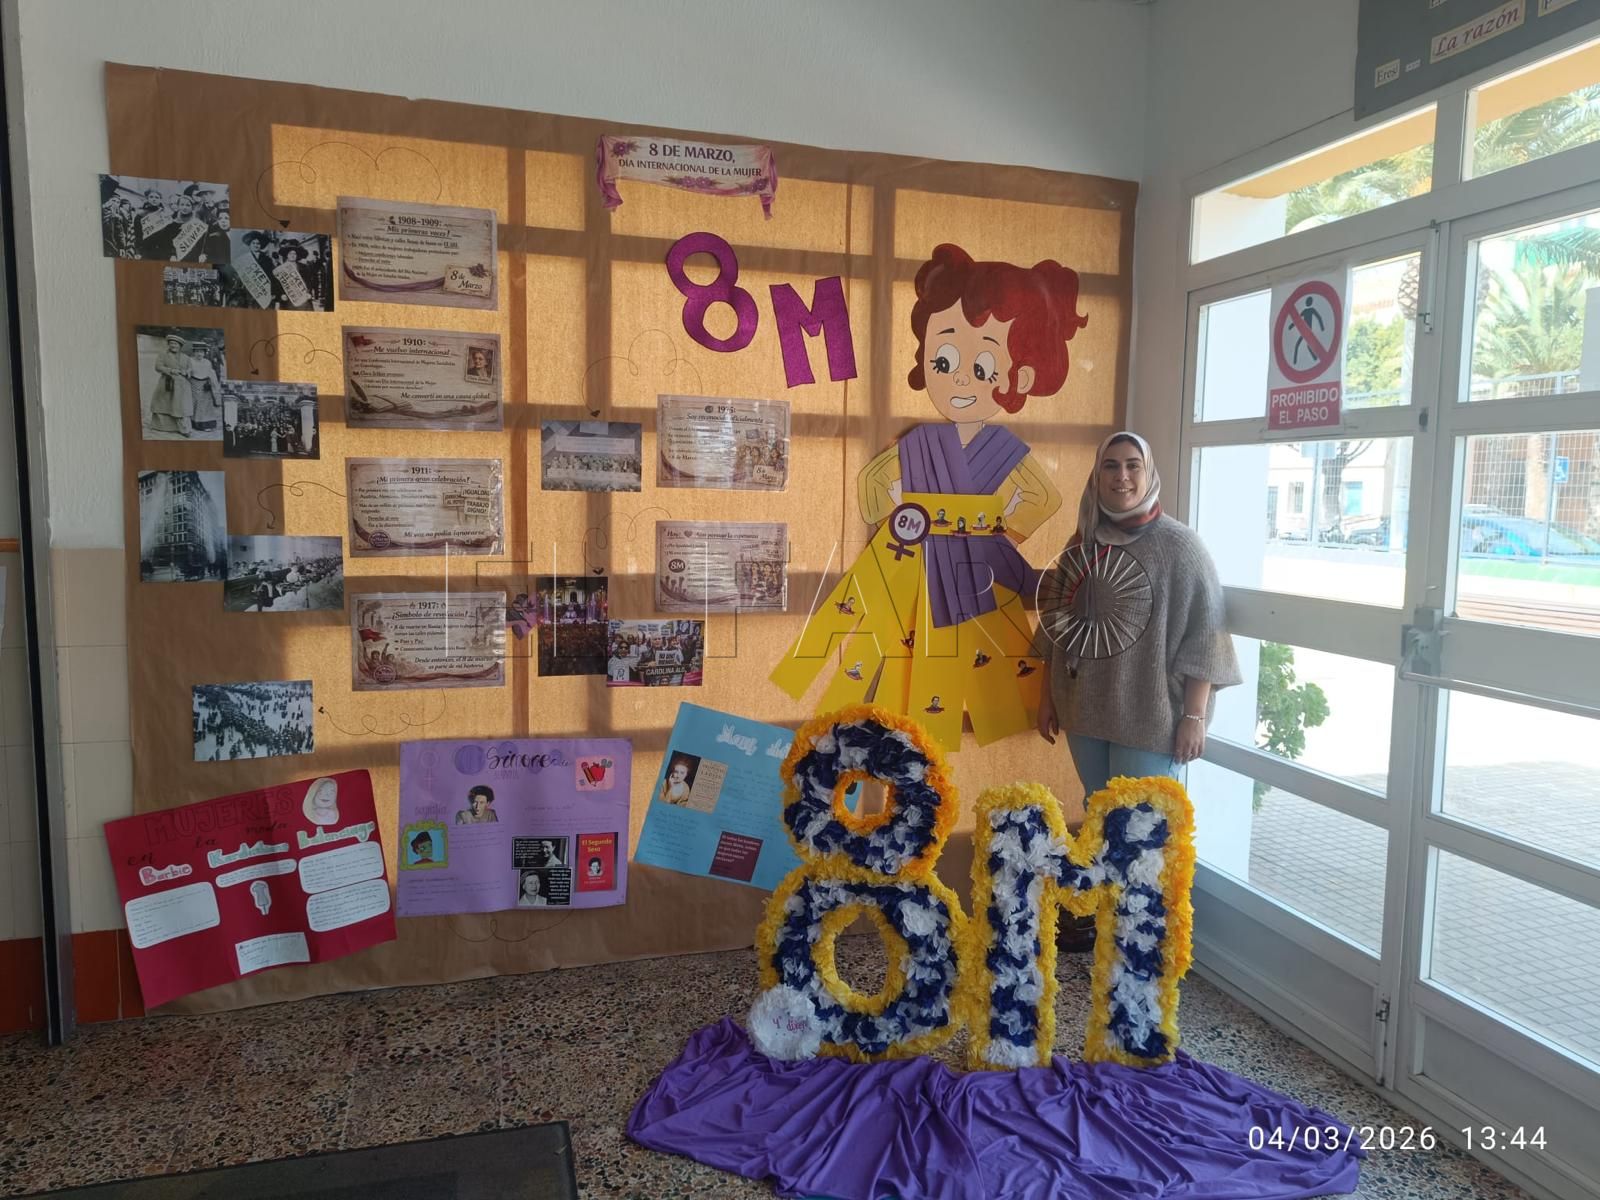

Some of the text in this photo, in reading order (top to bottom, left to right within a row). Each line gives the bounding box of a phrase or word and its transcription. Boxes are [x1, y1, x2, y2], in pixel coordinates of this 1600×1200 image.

[1436, 7, 1519, 56] La razón
[649, 143, 736, 164] 8 DE MARZO,
[637, 160, 706, 174] INTERNACIONAL
[709, 167, 720, 175] DE
[721, 168, 731, 176] LA
[733, 168, 762, 177] MUJER
[398, 216, 442, 227] 1908-1909:
[451, 271, 458, 280] 8
[458, 279, 483, 290] Marzo
[666, 232, 857, 388] 8M
[402, 337, 427, 346] 1910:
[1272, 387, 1339, 408] PROHIBIDO
[1279, 407, 1328, 424] EL PASO
[898, 515, 922, 534] 8M
[670, 561, 685, 570] 8M
[418, 602, 439, 610] 1917:
[141, 867, 191, 885] Barbie
